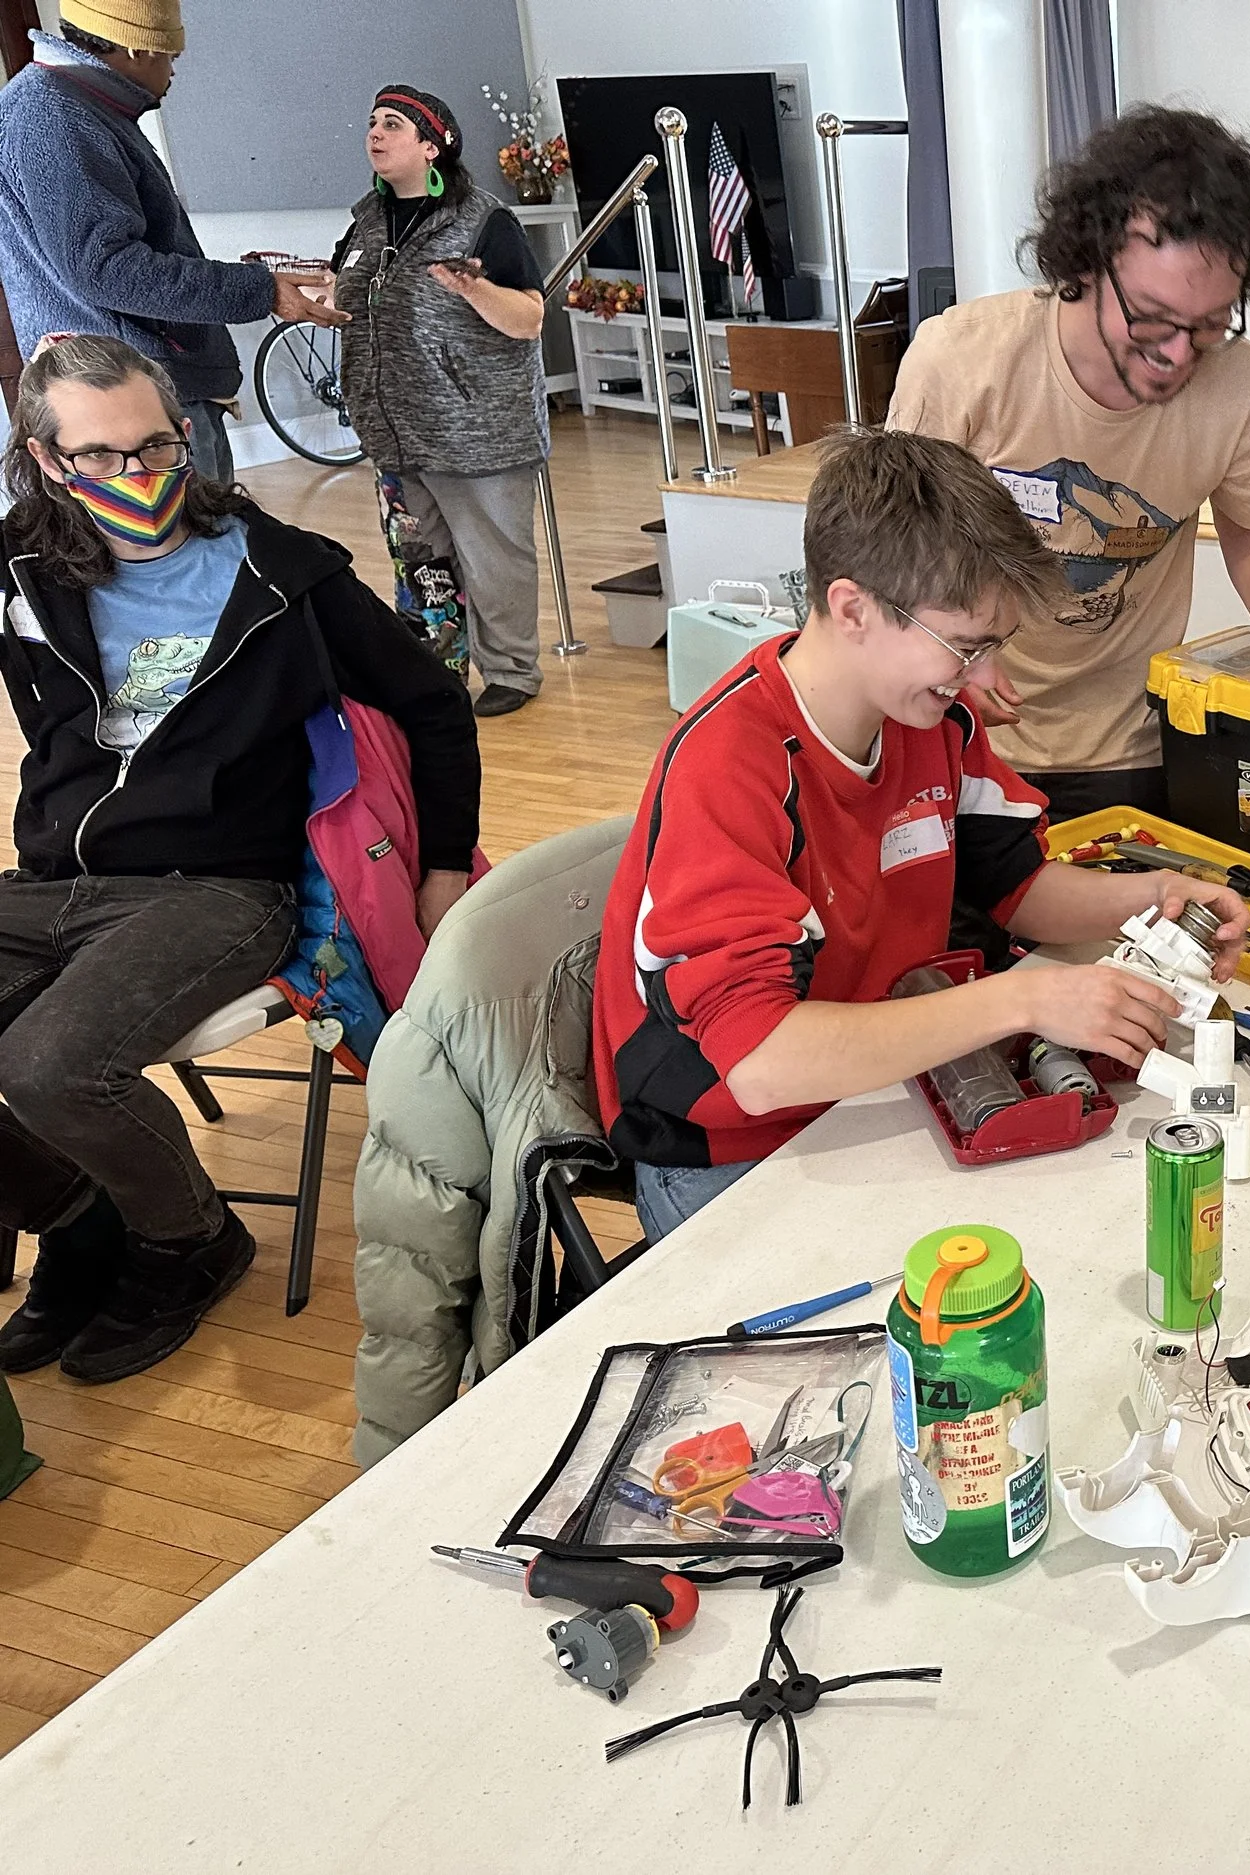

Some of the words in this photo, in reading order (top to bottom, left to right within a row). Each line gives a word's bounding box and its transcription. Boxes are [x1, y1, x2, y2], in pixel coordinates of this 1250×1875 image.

[892, 810, 910, 822] Hello
[914, 1378, 970, 1410] TZL
[971, 1444, 978, 1454] A
[941, 1453, 995, 1468] SITUATION
[1018, 1508, 1046, 1536] TRAILS
